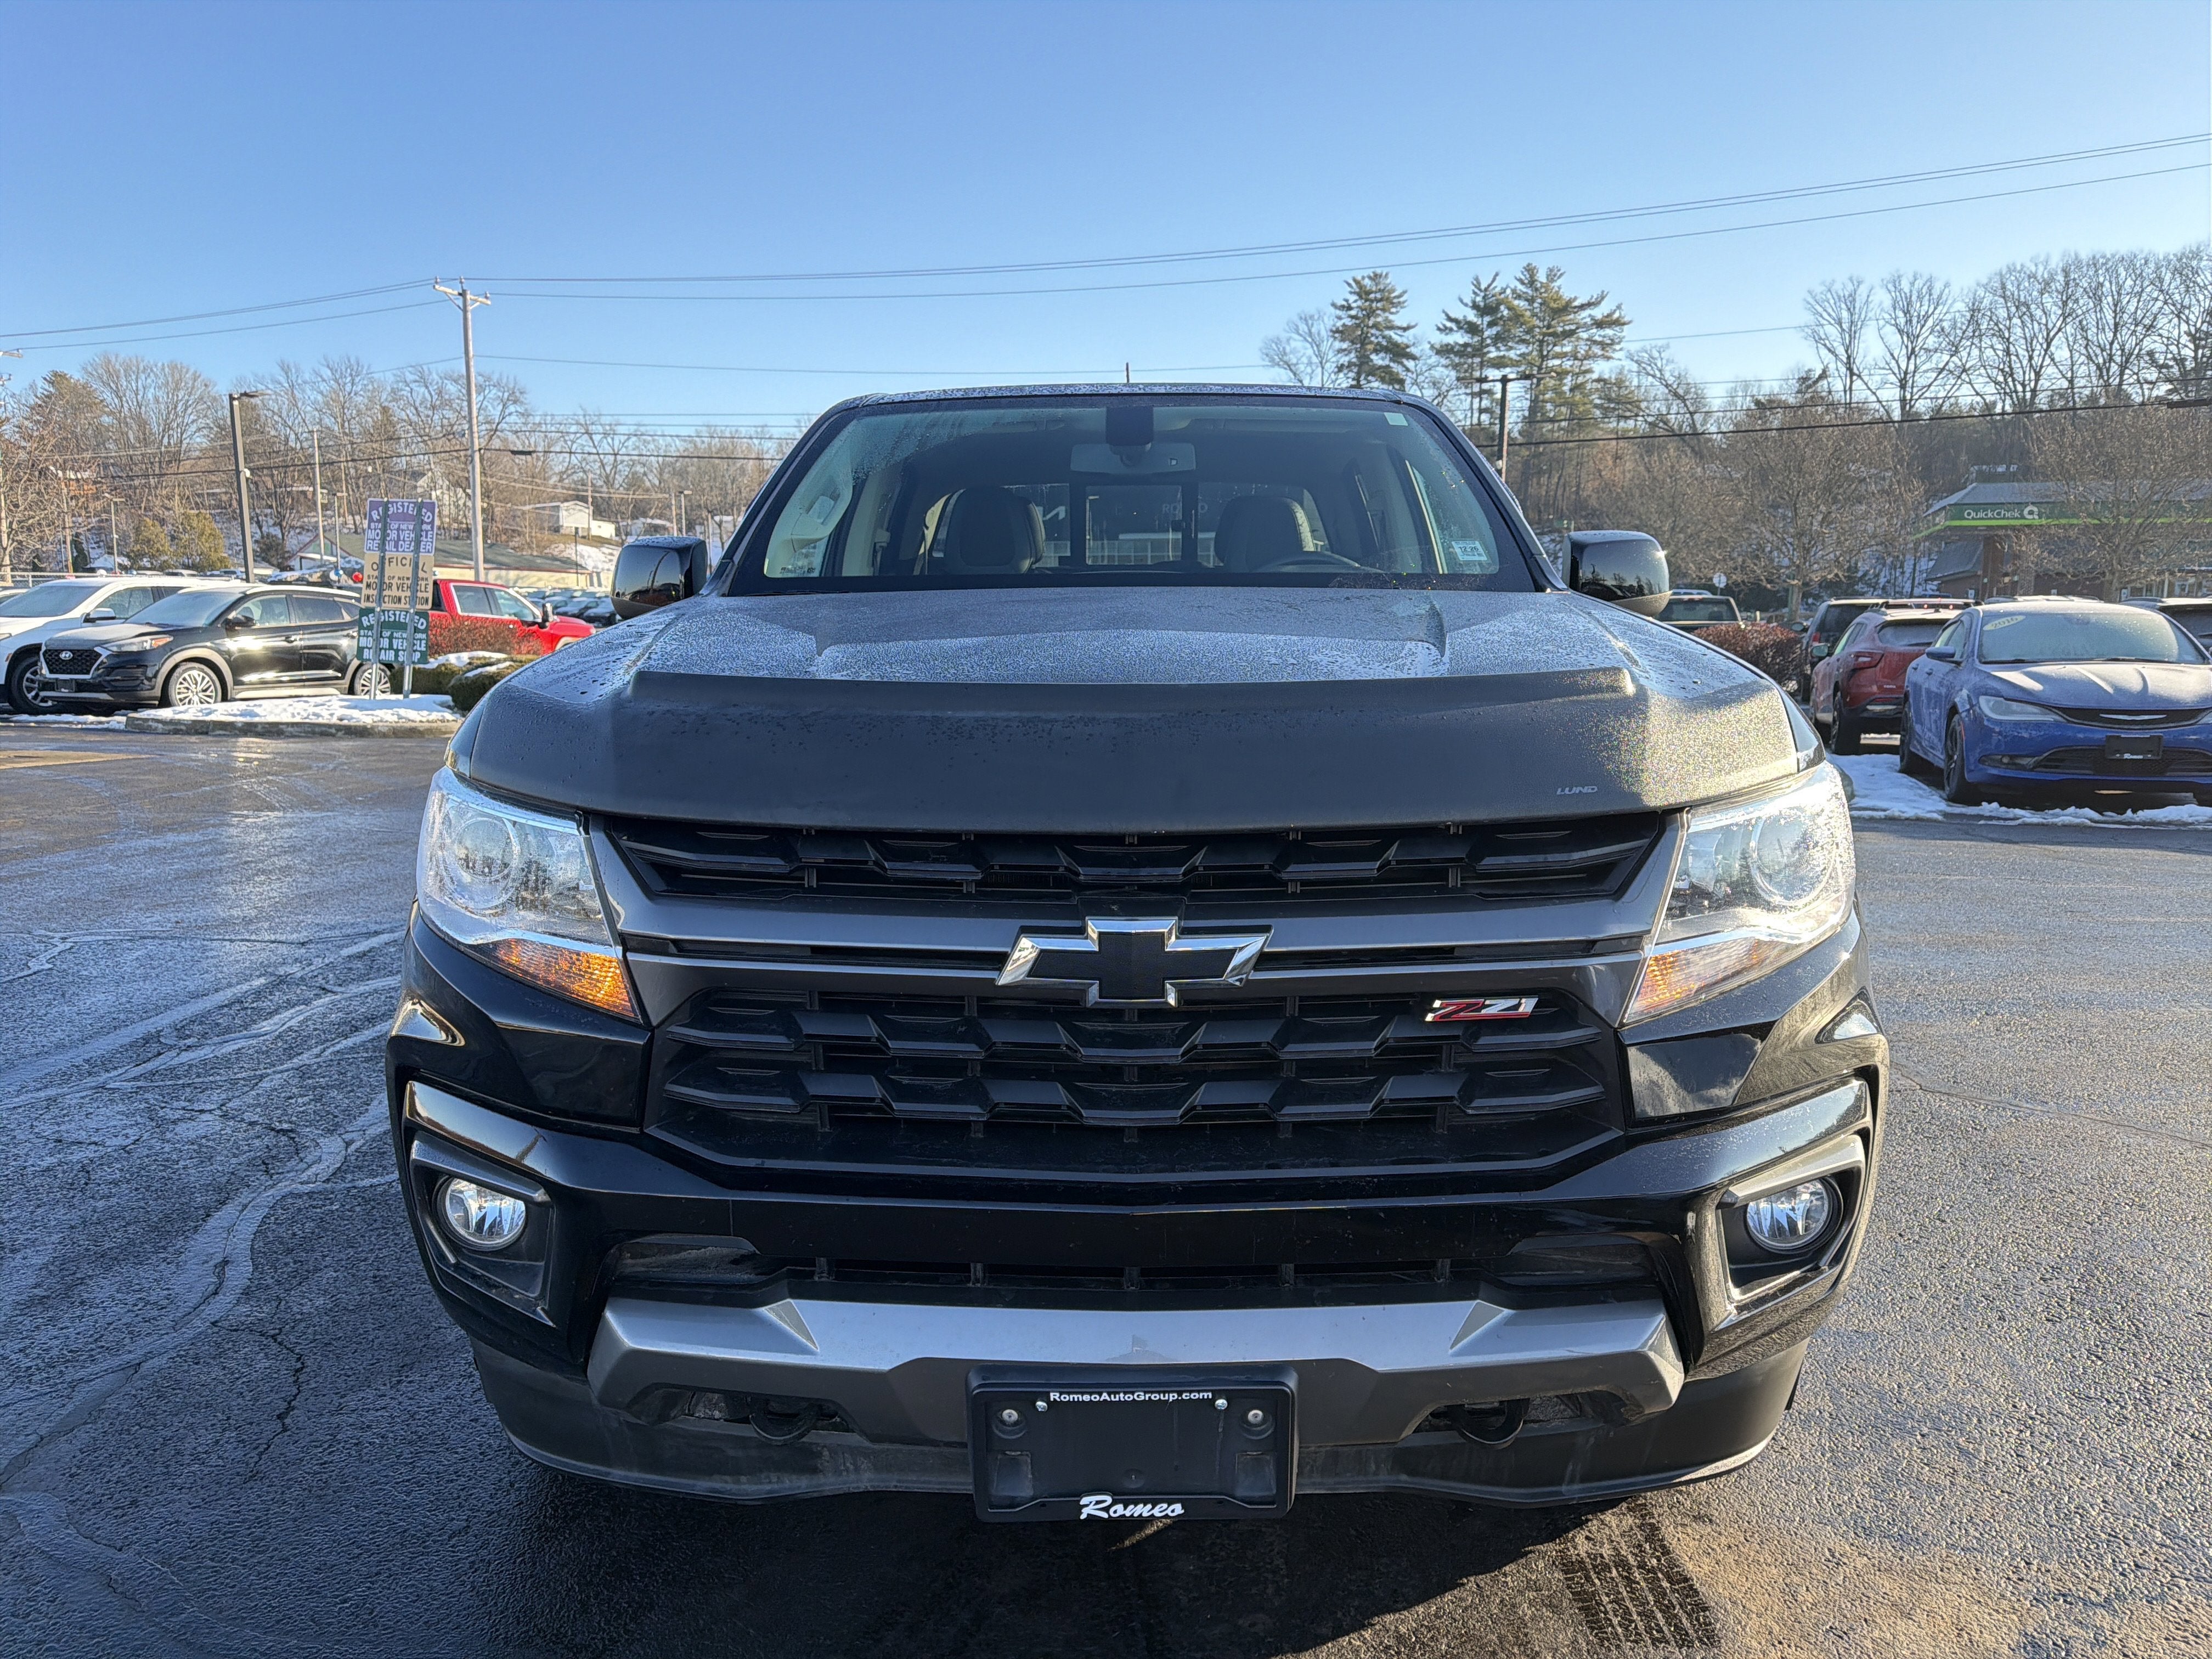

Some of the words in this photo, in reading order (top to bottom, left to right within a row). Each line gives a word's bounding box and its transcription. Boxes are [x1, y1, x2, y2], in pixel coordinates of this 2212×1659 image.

[1964, 509, 2021, 519] QuickChek
[368, 529, 397, 540] MOOR
[366, 540, 397, 551] REAIL
[398, 541, 432, 552] DEAER
[371, 556, 427, 573] OFICIL
[366, 581, 393, 591] MOOR
[396, 583, 430, 593] VEHLE
[364, 594, 402, 605] INSCTION
[1556, 786, 1598, 794] LUND
[1049, 1391, 1212, 1402] RomeoAutoGroup.com
[1079, 1494, 1184, 1520] Romeo
